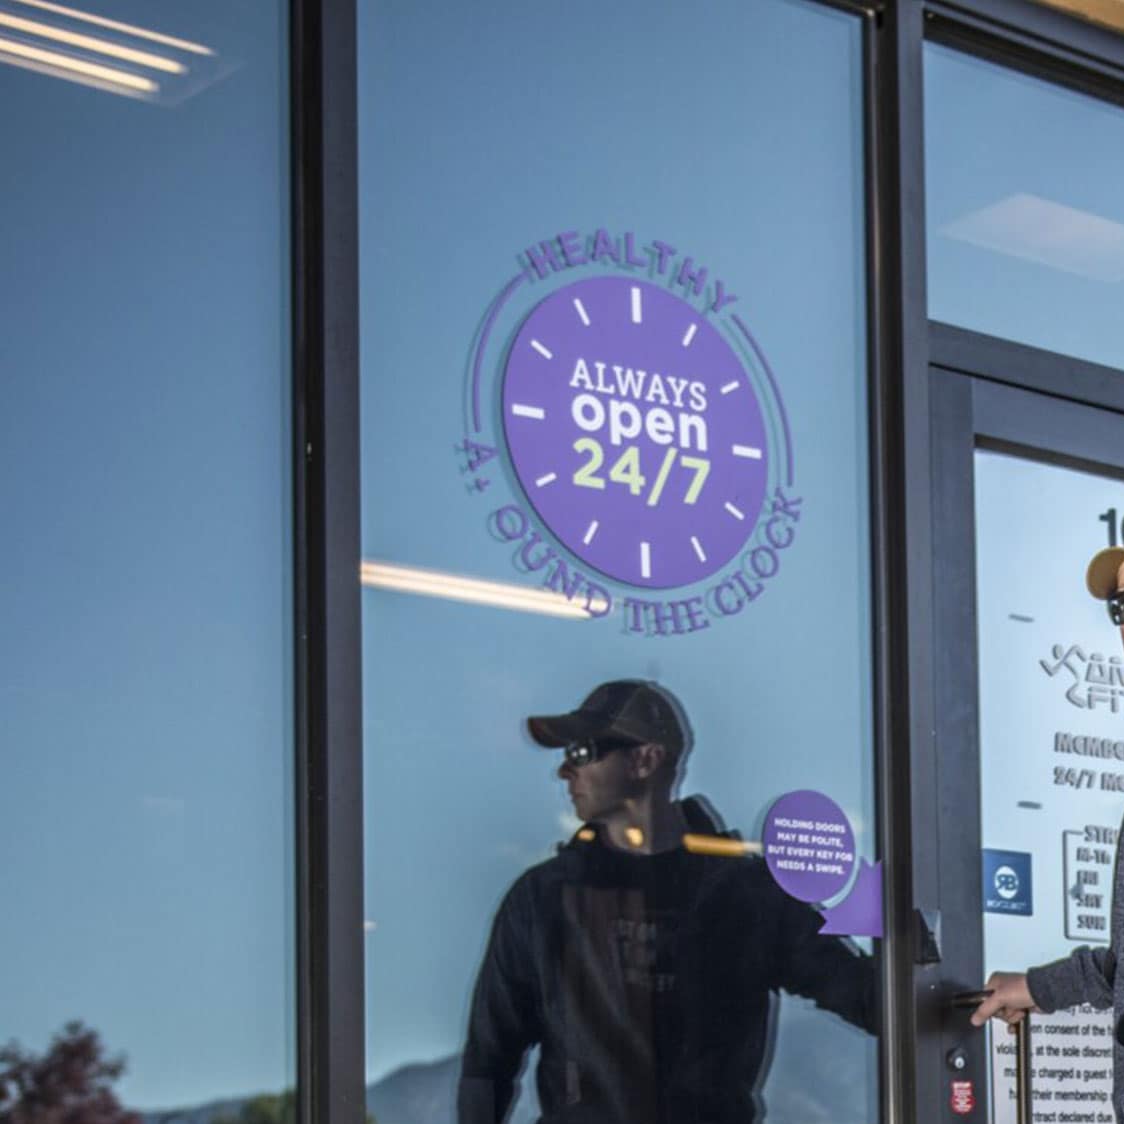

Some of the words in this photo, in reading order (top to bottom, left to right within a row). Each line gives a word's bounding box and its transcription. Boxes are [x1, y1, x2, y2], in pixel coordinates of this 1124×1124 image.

[521, 229, 737, 314] HEALTHY
[569, 359, 708, 411] ALWAYS
[571, 394, 708, 451] open
[572, 438, 711, 506] 24/7
[460, 437, 612, 619] AOUND
[623, 595, 710, 636] THE
[714, 487, 803, 617] CLOCK
[1054, 766, 1096, 789] 24/7
[774, 818, 814, 830] HOLDING
[815, 821, 846, 833] DOORS
[777, 832, 796, 842] MAY
[798, 834, 810, 844] BE
[811, 835, 844, 848] POLITE,
[767, 844, 785, 855] BUT
[786, 847, 814, 858] EVERY
[816, 849, 834, 860] KEY
[776, 860, 805, 871] NEEDS
[807, 863, 814, 871] A
[815, 864, 845, 875] SWIPE.
[1044, 1025, 1079, 1035] consent
[1081, 1023, 1091, 1035] of
[1092, 1025, 1106, 1036] the
[1036, 1046, 1044, 1056] at
[1046, 1045, 1060, 1056] the
[1062, 1046, 1080, 1057] sole
[1038, 1067, 1074, 1082] charged
[1083, 1068, 1107, 1082] guest
[1054, 1090, 1108, 1104] membership
[1058, 1111, 1095, 1123] declared
[1097, 1112, 1113, 1123] due
